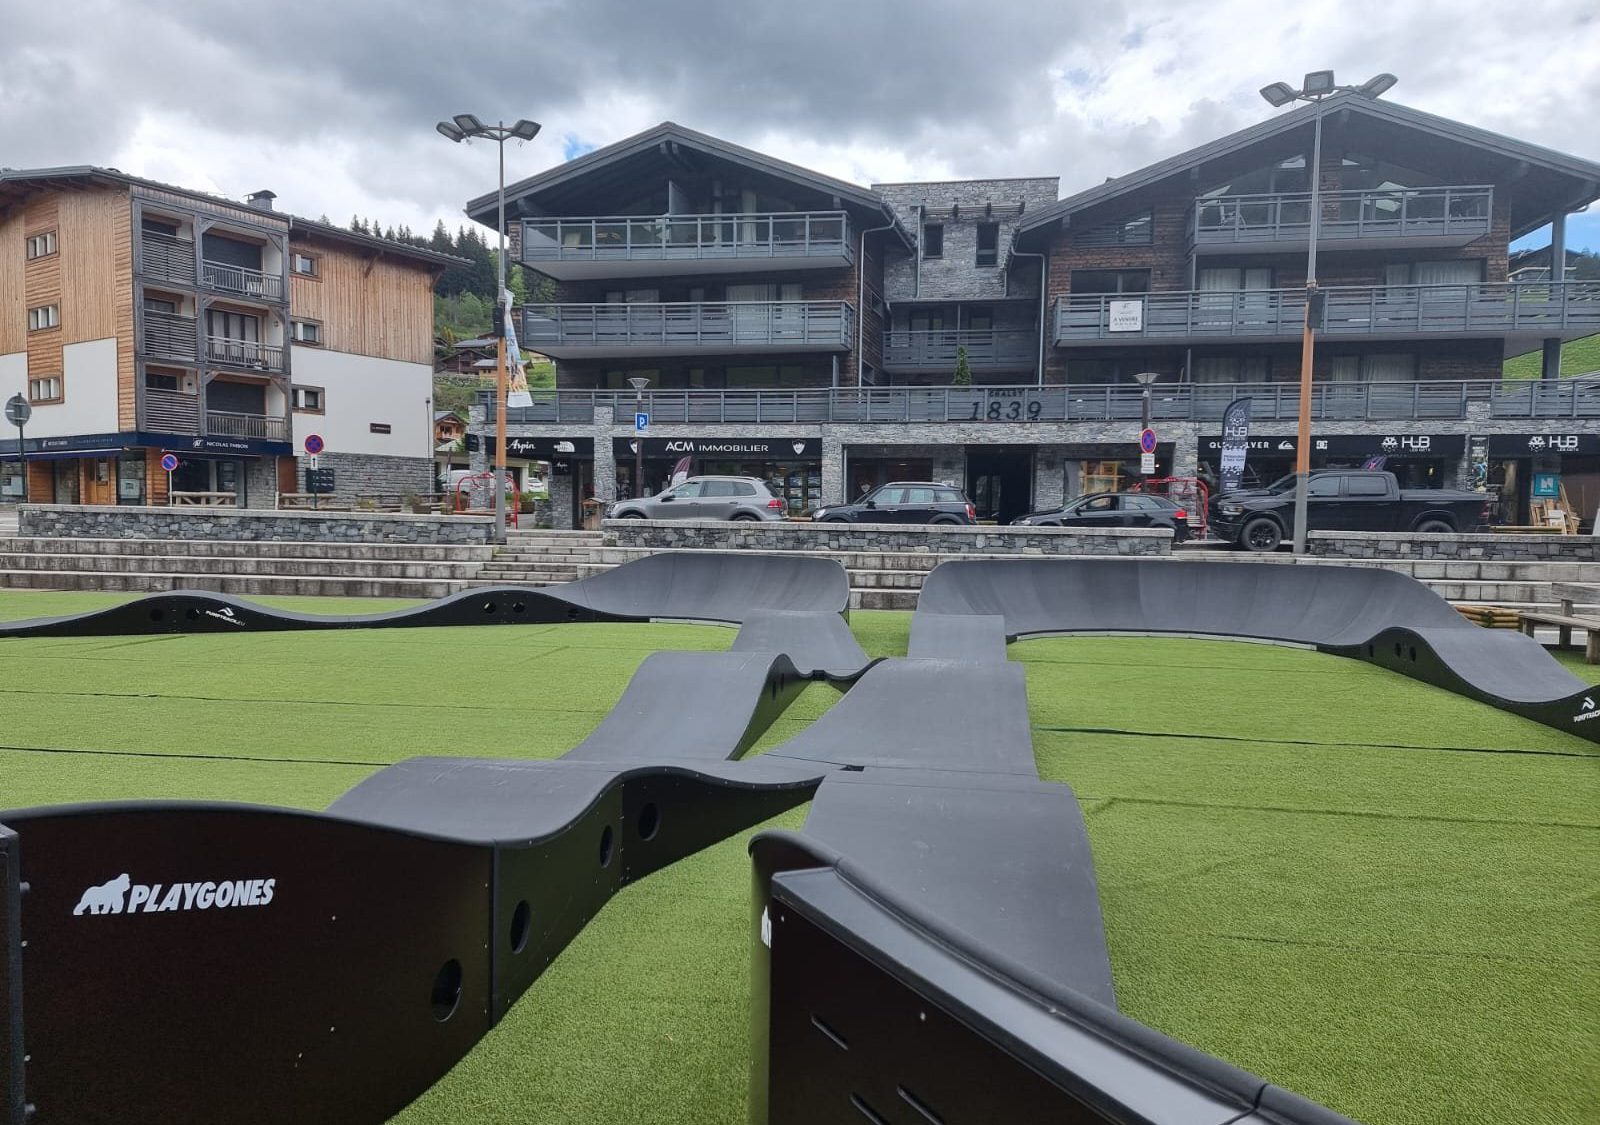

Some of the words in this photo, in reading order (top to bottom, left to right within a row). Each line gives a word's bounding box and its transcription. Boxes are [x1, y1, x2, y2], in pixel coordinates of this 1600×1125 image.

[989, 390, 1023, 398] CHALET
[968, 401, 1042, 421] 1839
[639, 417, 645, 428] P
[1225, 426, 1248, 437] HUB
[505, 439, 536, 454] Arpin
[665, 441, 695, 452] ACM
[1401, 436, 1430, 448] HUB
[1549, 435, 1578, 448] HUB
[127, 878, 276, 914] PLAYGONES
